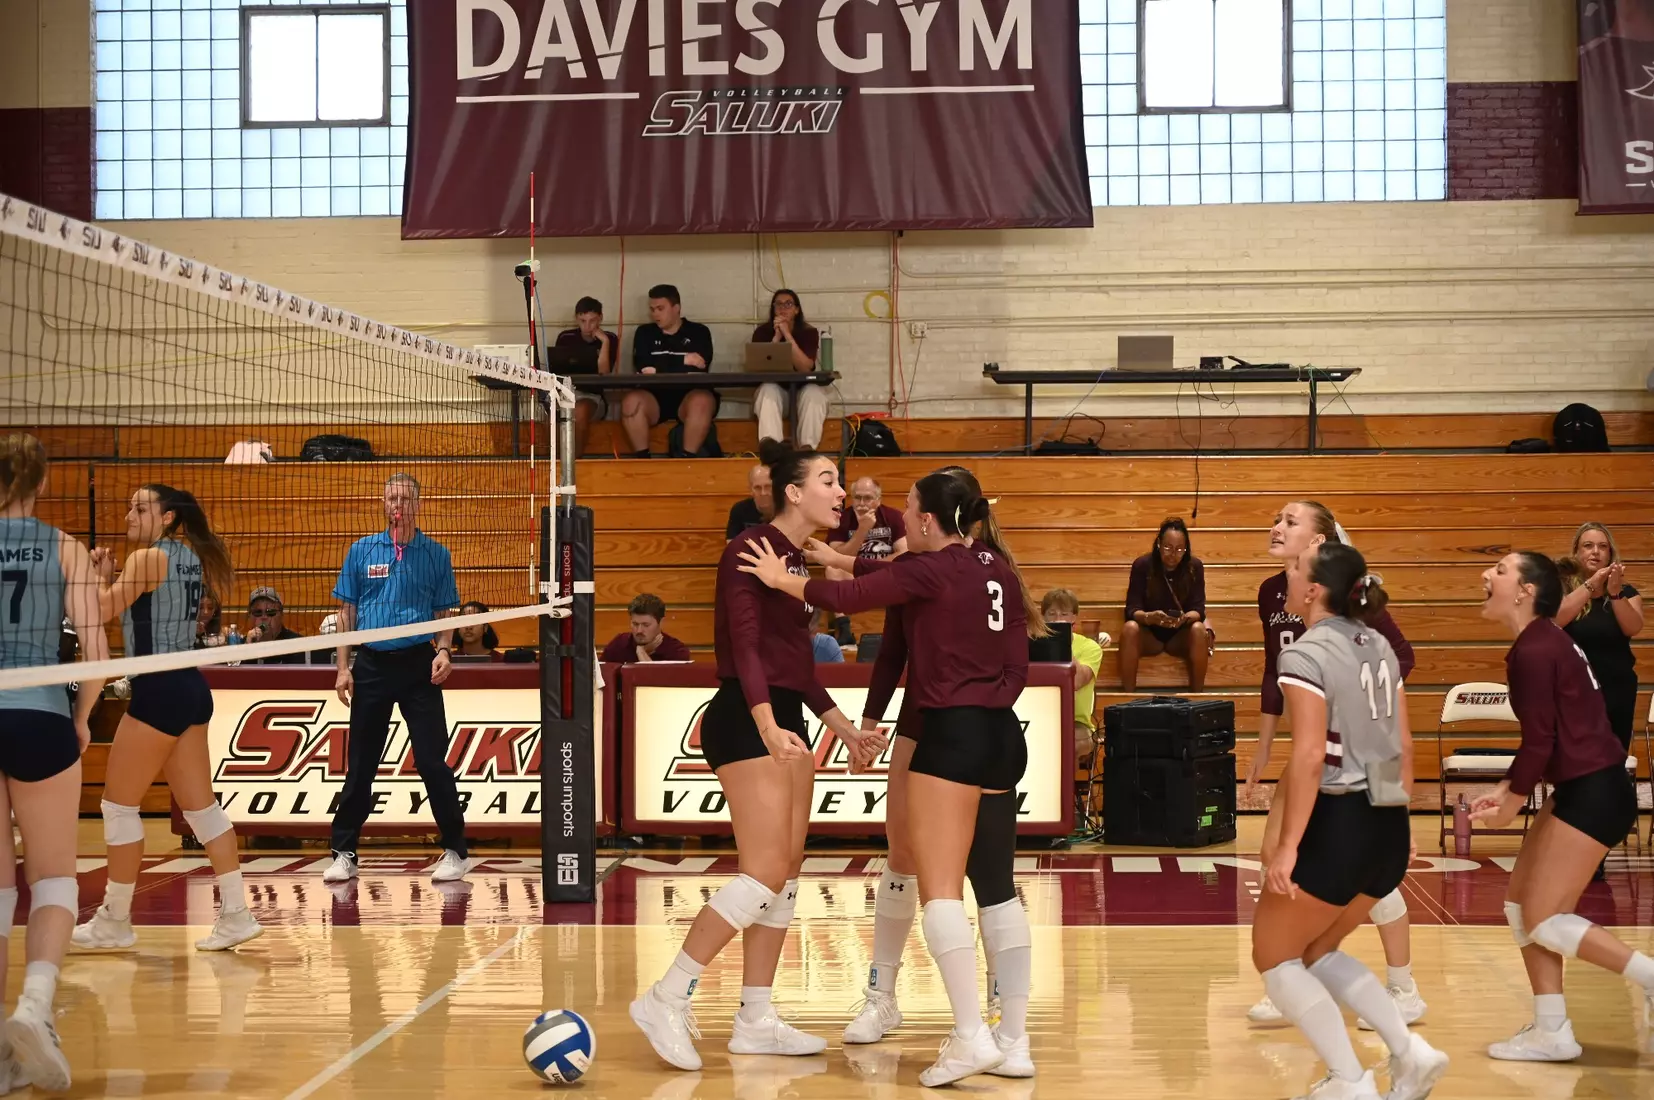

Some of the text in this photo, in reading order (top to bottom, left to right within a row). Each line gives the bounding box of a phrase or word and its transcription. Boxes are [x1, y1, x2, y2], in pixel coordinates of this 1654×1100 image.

[456, 0, 1032, 81] DAVIES GYM
[642, 90, 843, 136] SALUKI
[712, 87, 843, 97] VOLLEYBALL
[27, 206, 47, 233] SIU
[83, 226, 101, 250] SIU
[132, 242, 149, 265] SIU
[178, 258, 193, 279] SIU
[219, 271, 232, 291] SIU
[1, 569, 28, 625] 7
[184, 581, 202, 621] 19
[986, 580, 1004, 632] 3
[1360, 658, 1393, 721] 11
[560, 742, 575, 784] sports
[560, 785, 575, 837] imports
